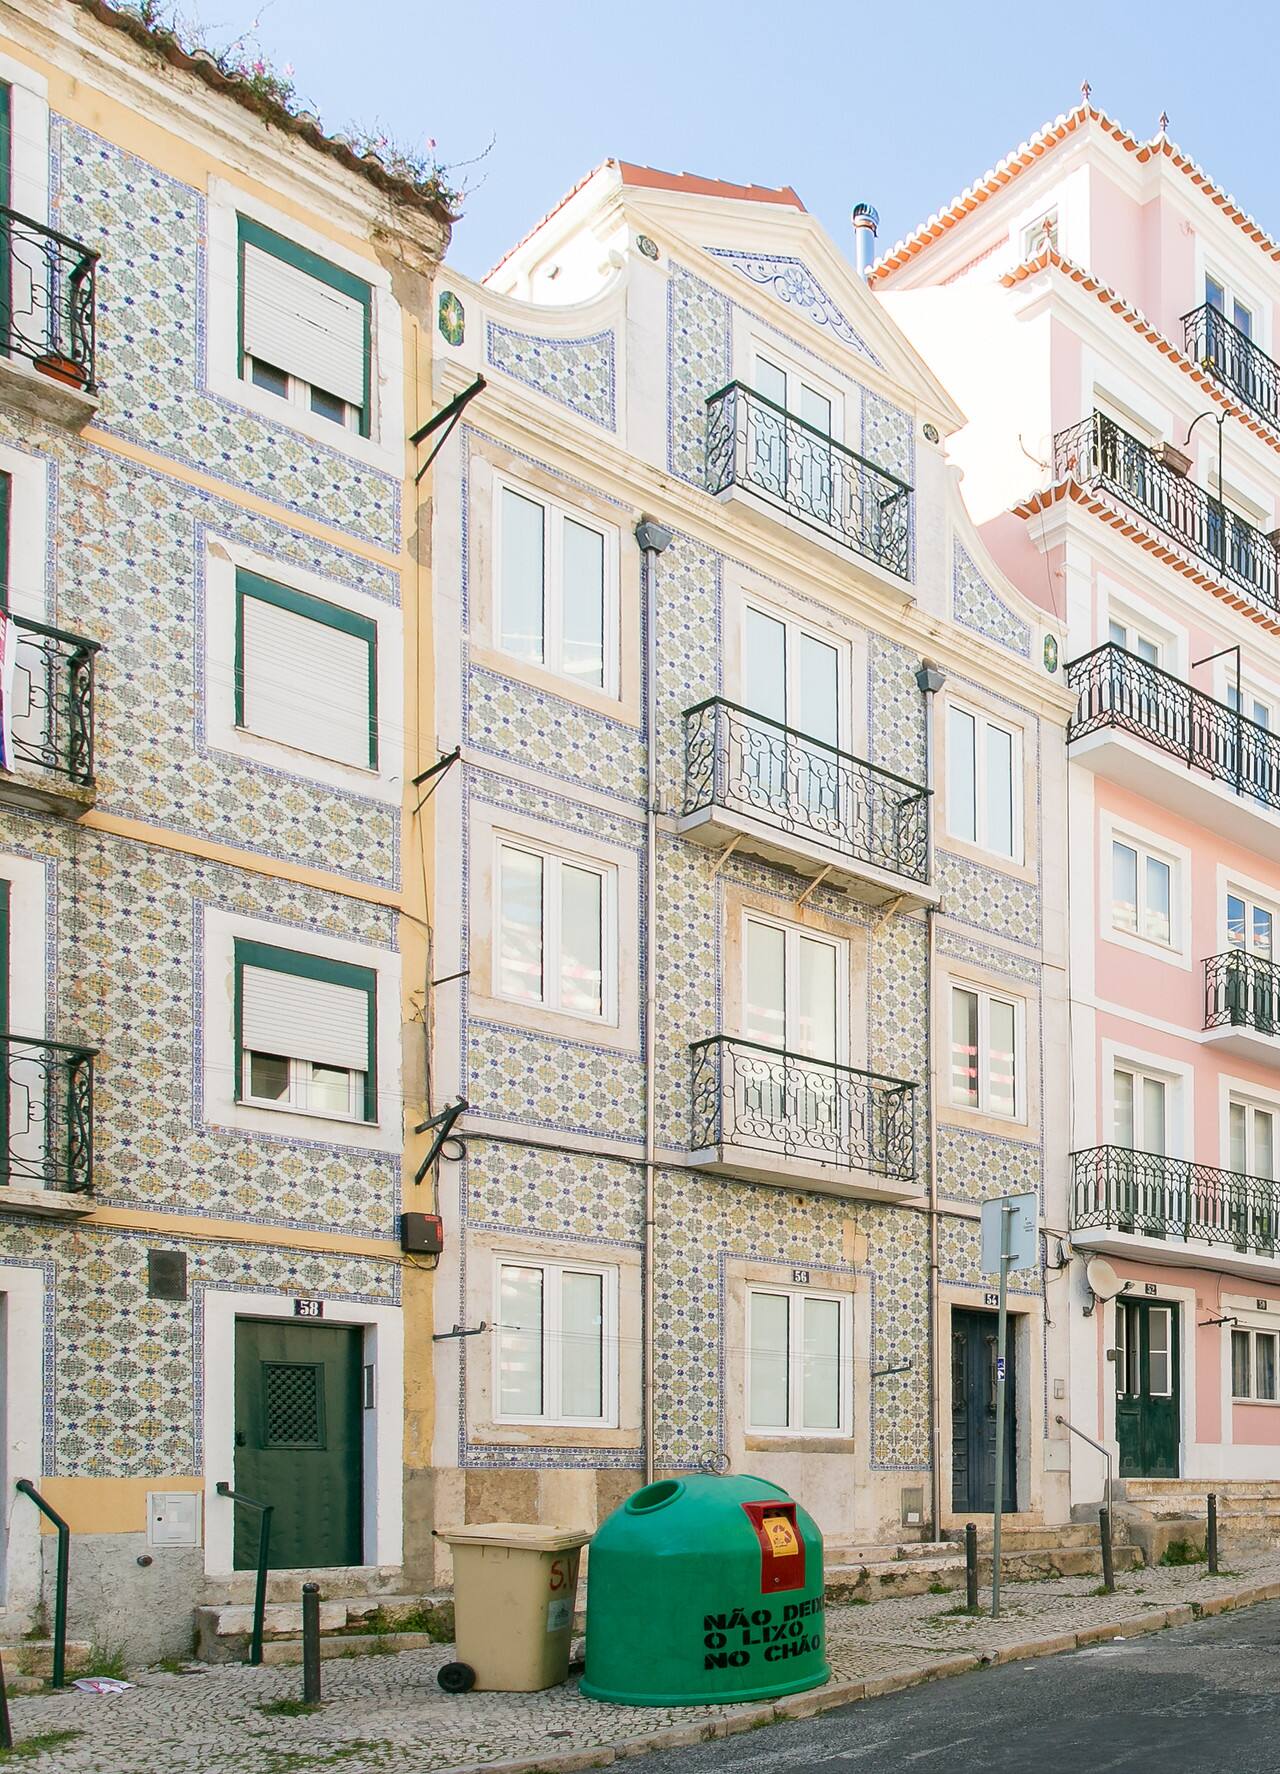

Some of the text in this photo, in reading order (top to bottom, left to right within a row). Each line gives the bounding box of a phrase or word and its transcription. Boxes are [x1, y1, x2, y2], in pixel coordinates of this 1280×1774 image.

[795, 1270, 807, 1283] 56
[1146, 1284, 1156, 1295] 52
[299, 1300, 319, 1316] 58
[986, 1294, 997, 1306] 54
[704, 1607, 772, 1631] NÃO
[704, 1621, 804, 1649] O LIXO
[704, 1633, 821, 1670] NO CHÃO
